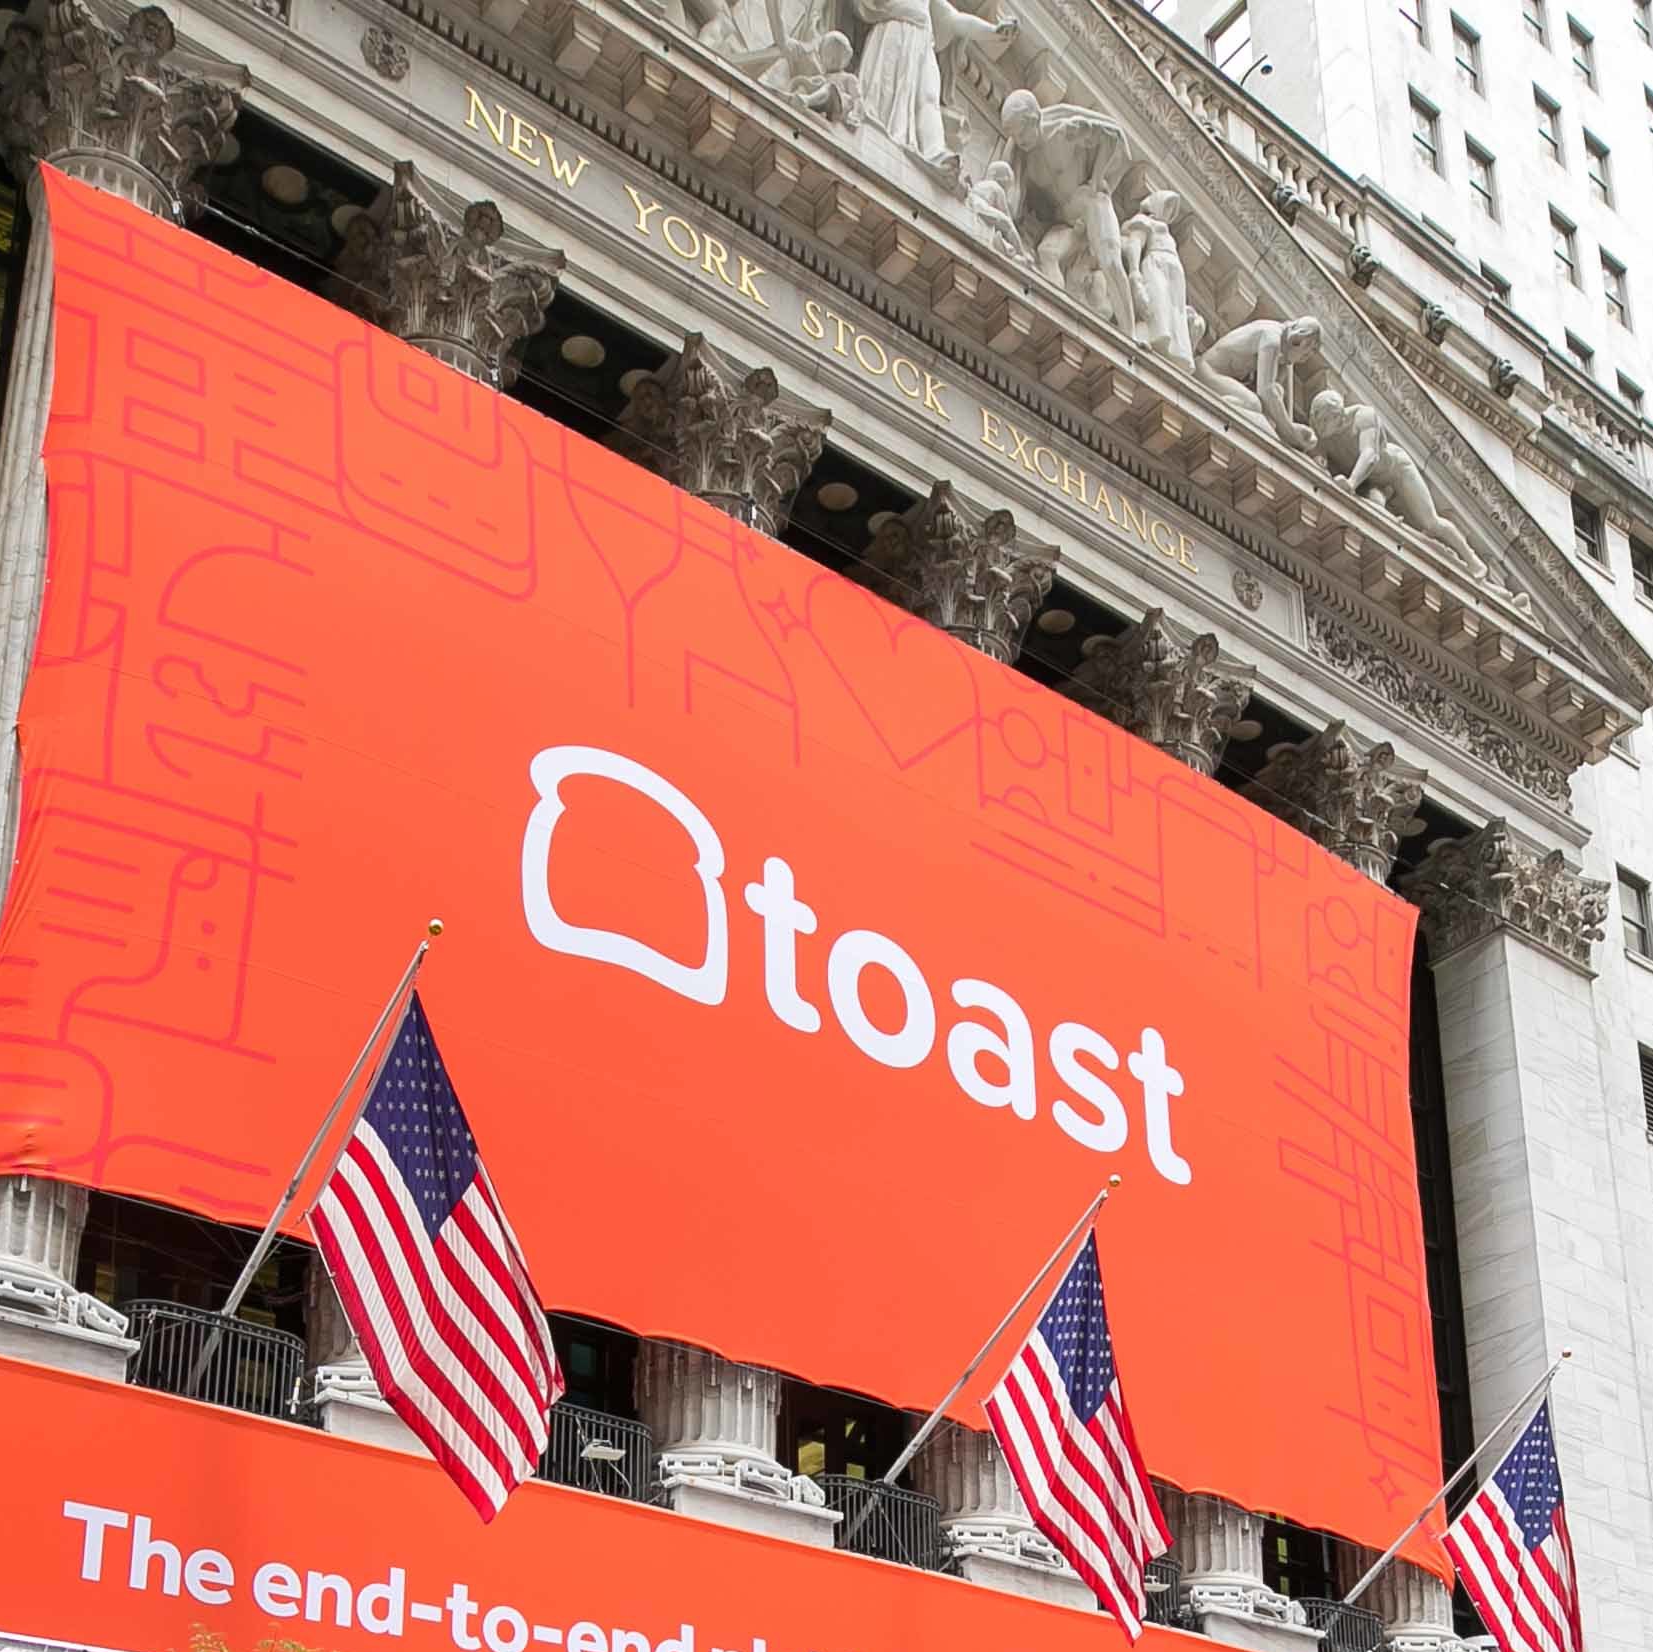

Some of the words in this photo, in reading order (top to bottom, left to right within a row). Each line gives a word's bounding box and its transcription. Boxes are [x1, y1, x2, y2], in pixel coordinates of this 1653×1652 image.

[464, 84, 591, 190] NEW
[623, 183, 771, 310] YORK
[801, 301, 952, 422] STOCK
[979, 413, 1201, 576] EXCHANGE
[745, 857, 1192, 1185] toast
[64, 1500, 235, 1605] The
